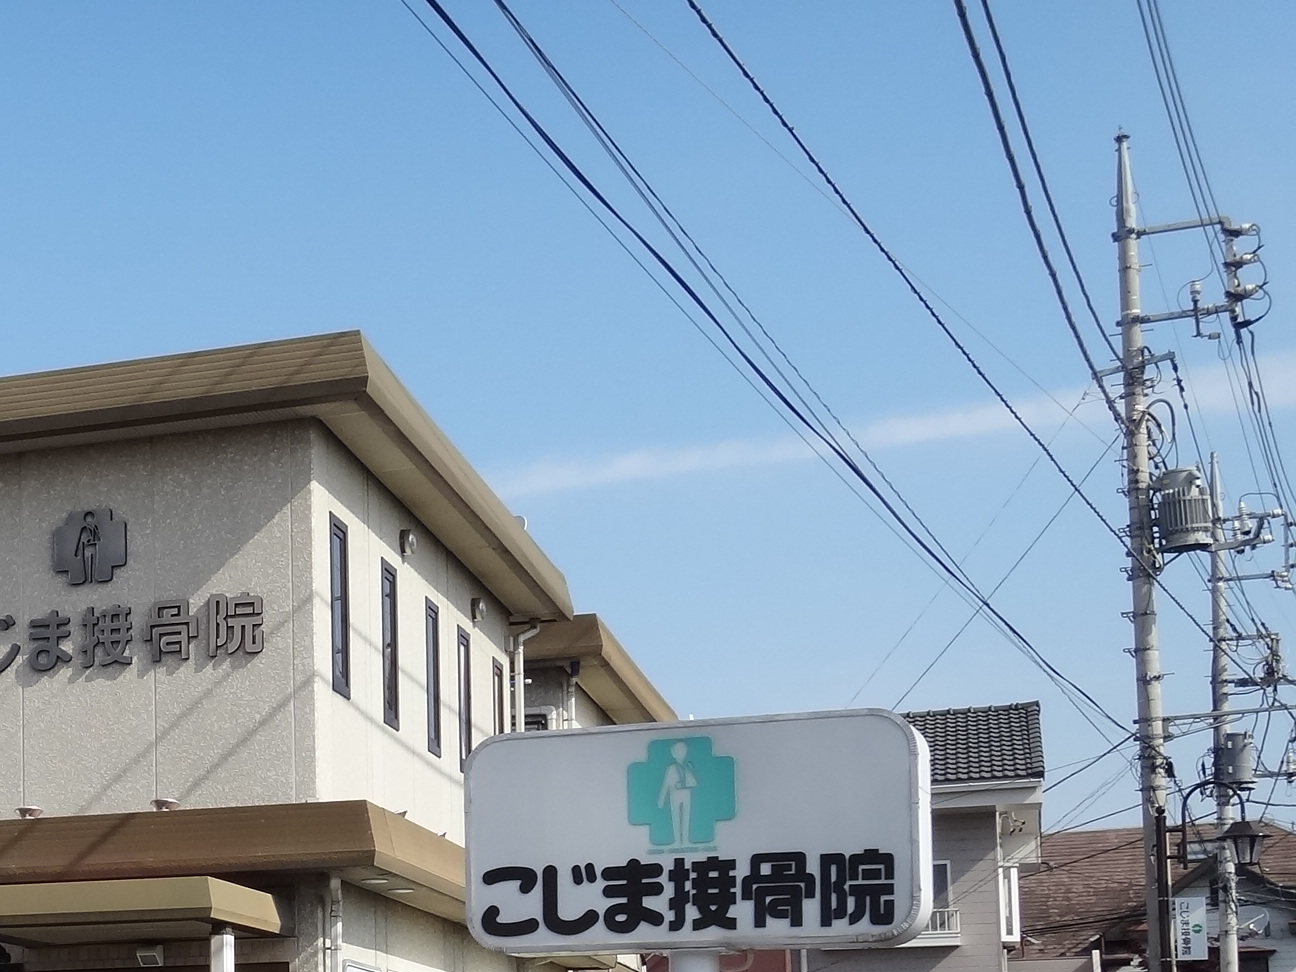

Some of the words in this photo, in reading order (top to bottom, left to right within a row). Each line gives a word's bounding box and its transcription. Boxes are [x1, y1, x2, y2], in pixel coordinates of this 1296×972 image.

[482, 848, 895, 937] こじま接骨院
